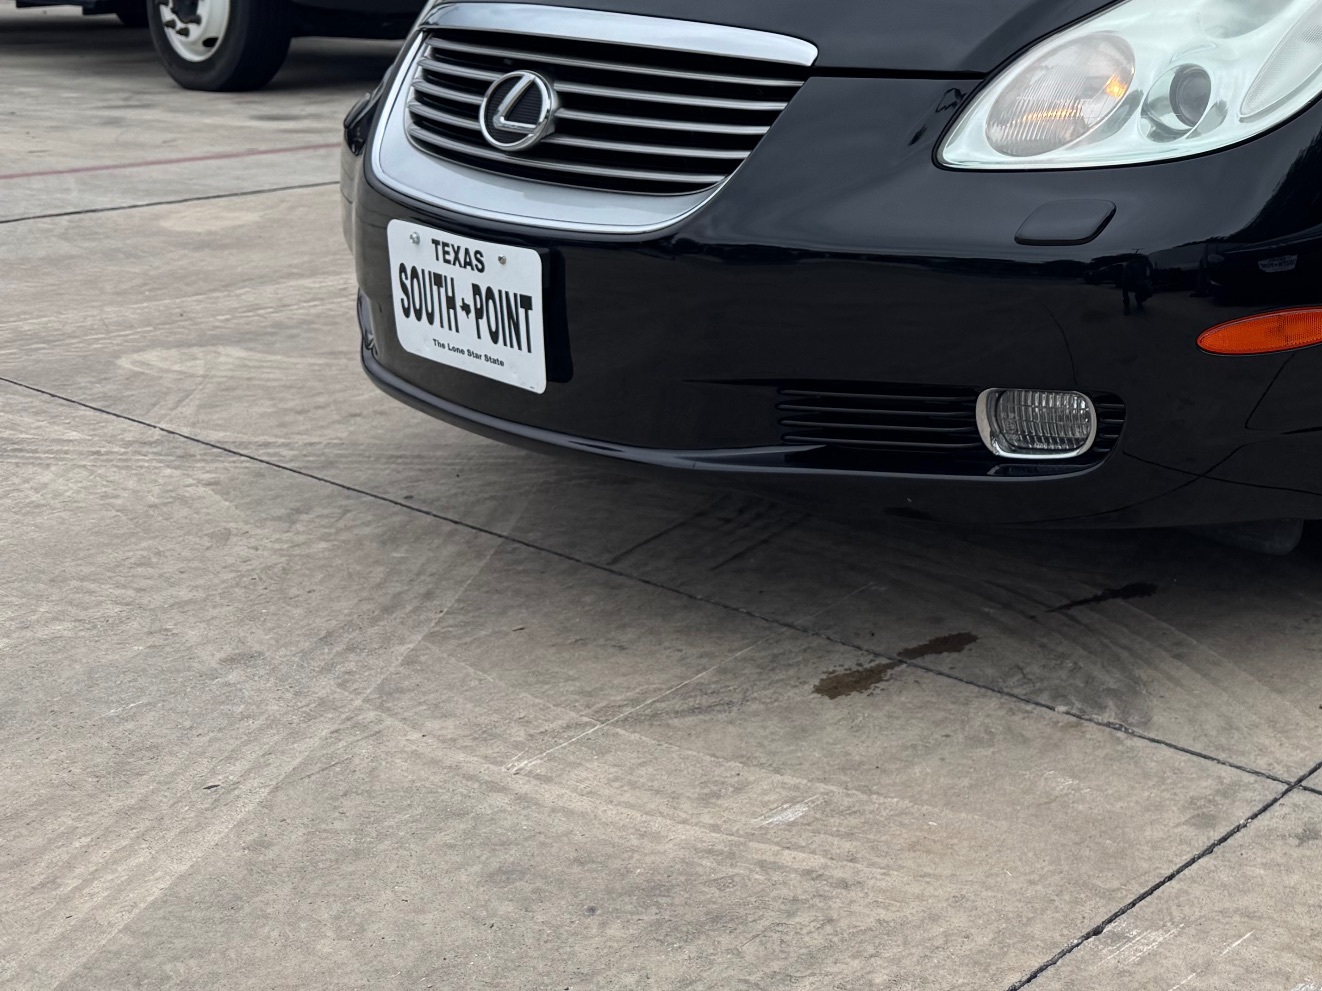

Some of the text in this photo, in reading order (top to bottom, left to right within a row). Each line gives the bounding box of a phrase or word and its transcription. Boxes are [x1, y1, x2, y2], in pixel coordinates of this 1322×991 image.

[431, 238, 486, 274] TEXAS
[399, 262, 533, 354] SOUTH POINT
[432, 338, 505, 367] The Lone Star State
